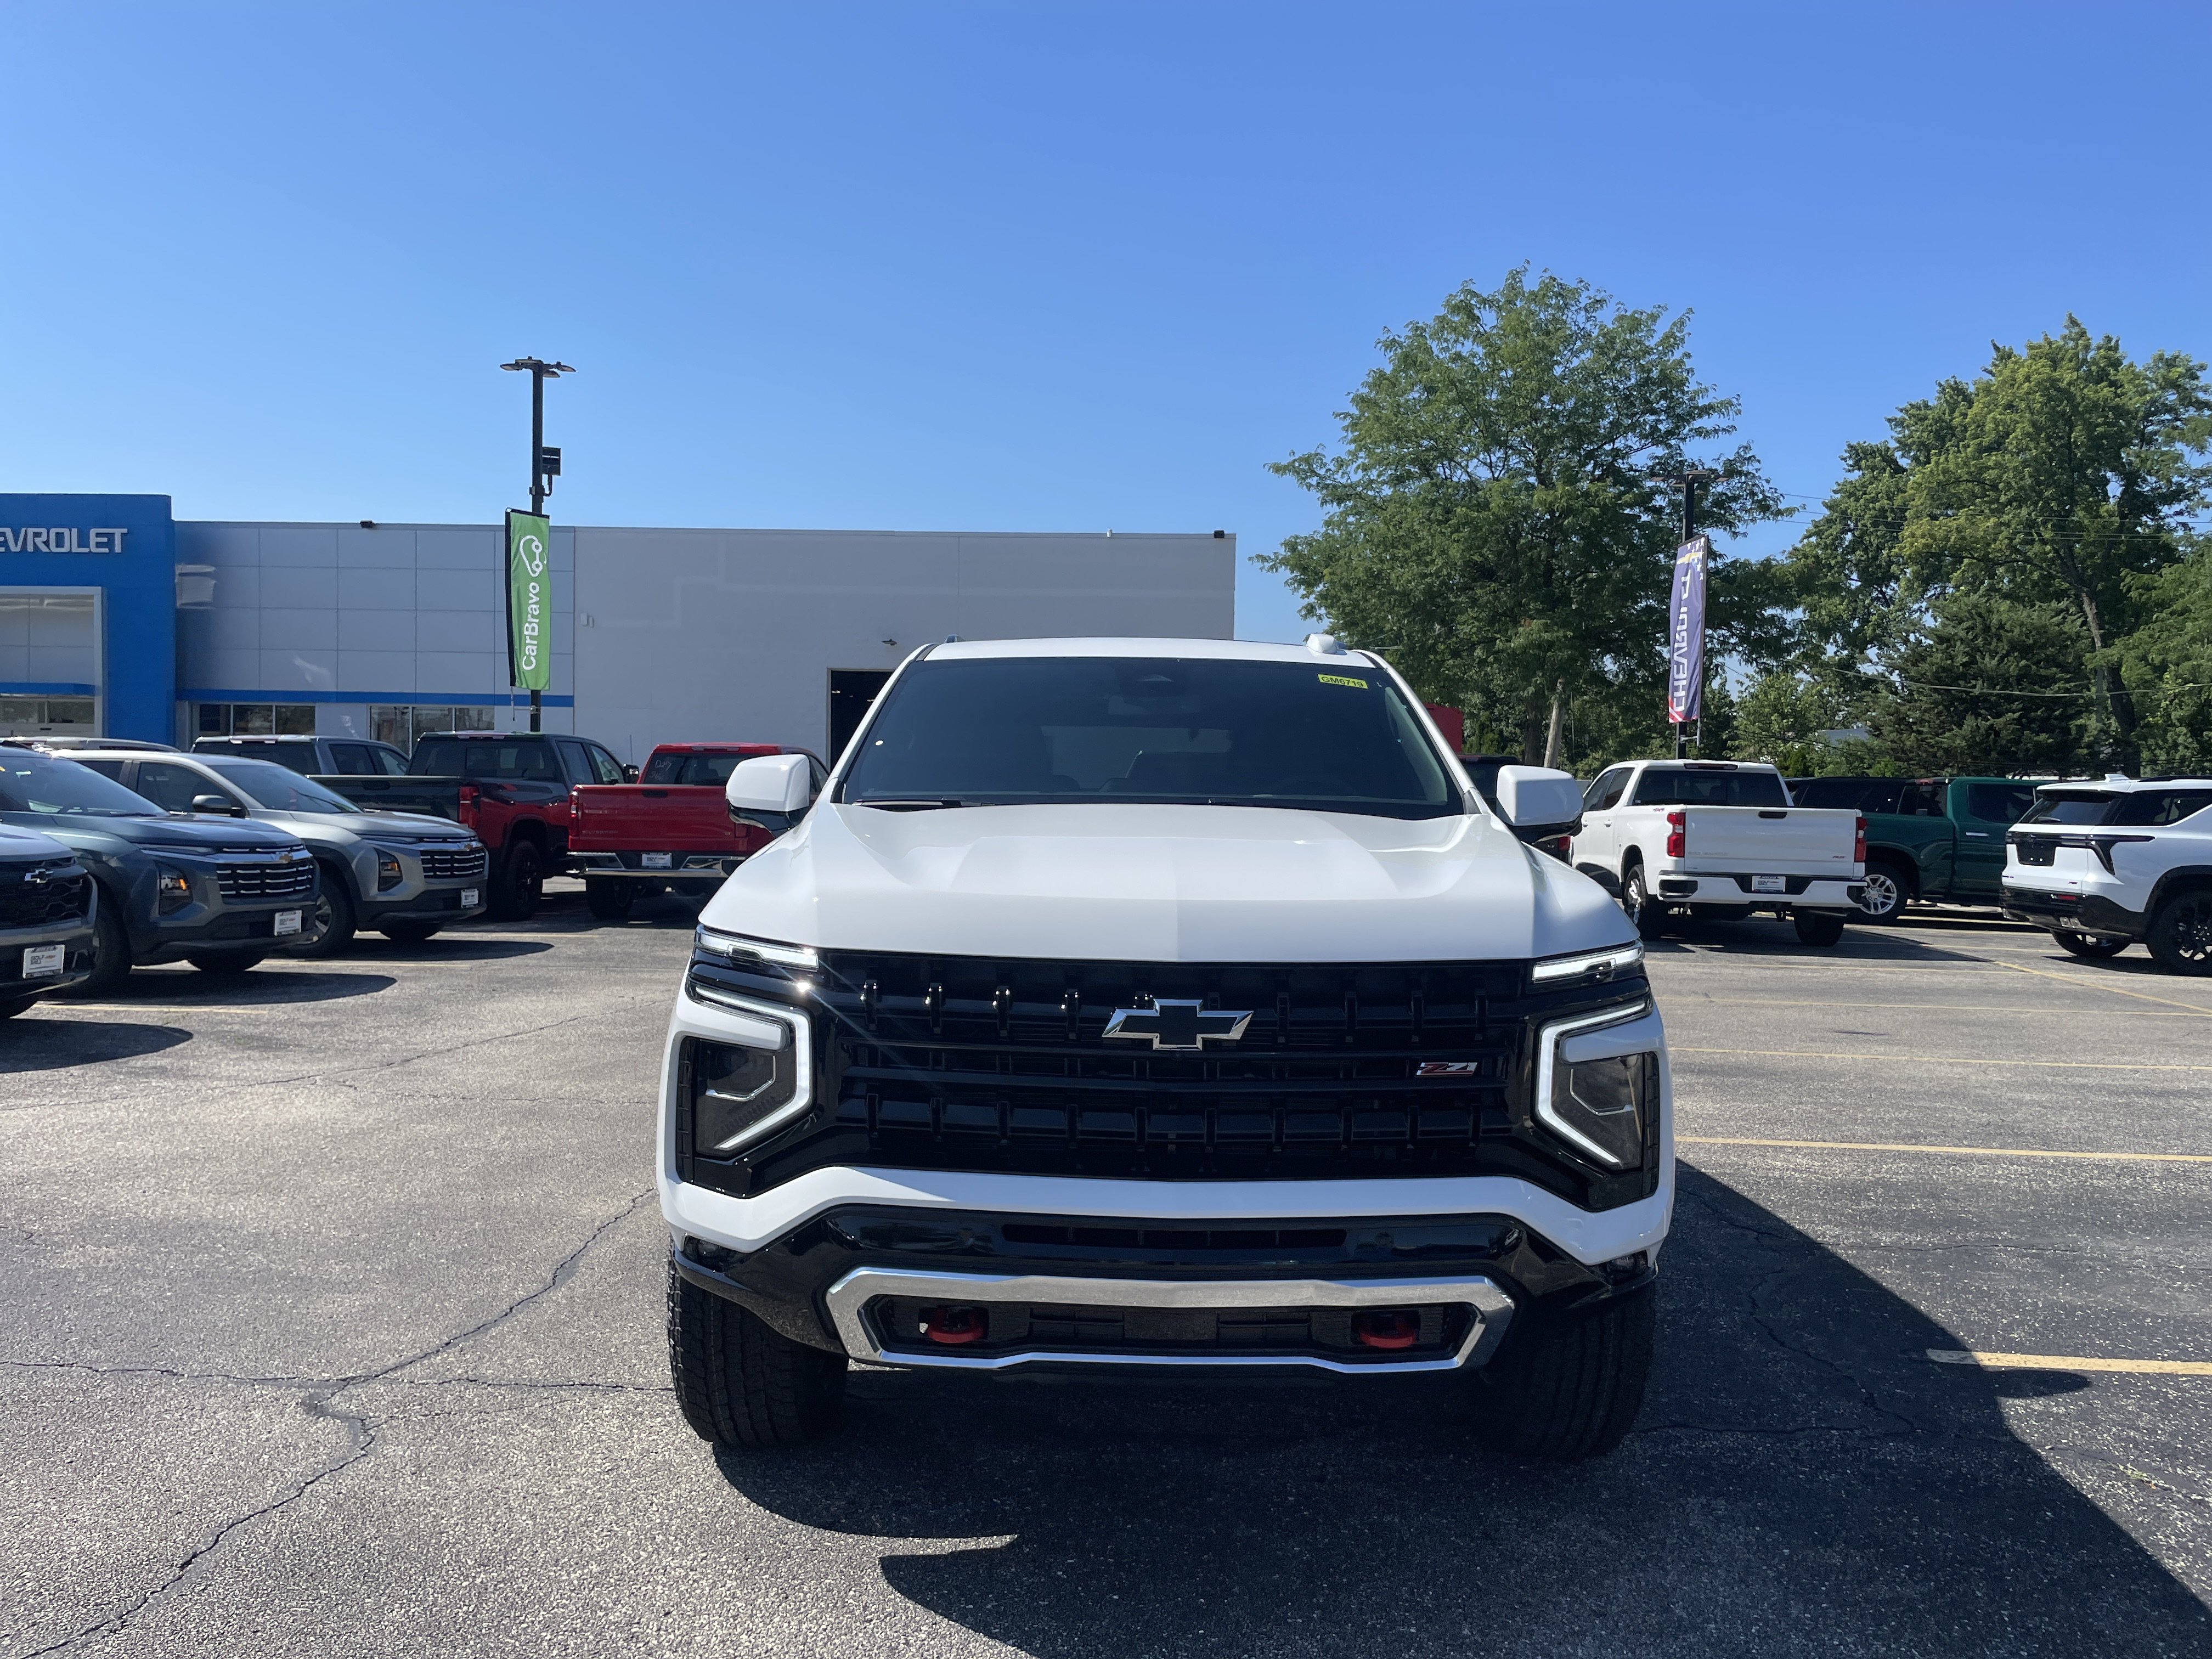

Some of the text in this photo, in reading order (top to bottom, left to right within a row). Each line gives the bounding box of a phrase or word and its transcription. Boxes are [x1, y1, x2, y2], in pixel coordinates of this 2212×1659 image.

[0, 528, 128, 553] VROLET
[522, 582, 540, 670] CarBravo
[1322, 676, 1364, 689] GM6719
[1416, 1062, 1478, 1075] Z71
